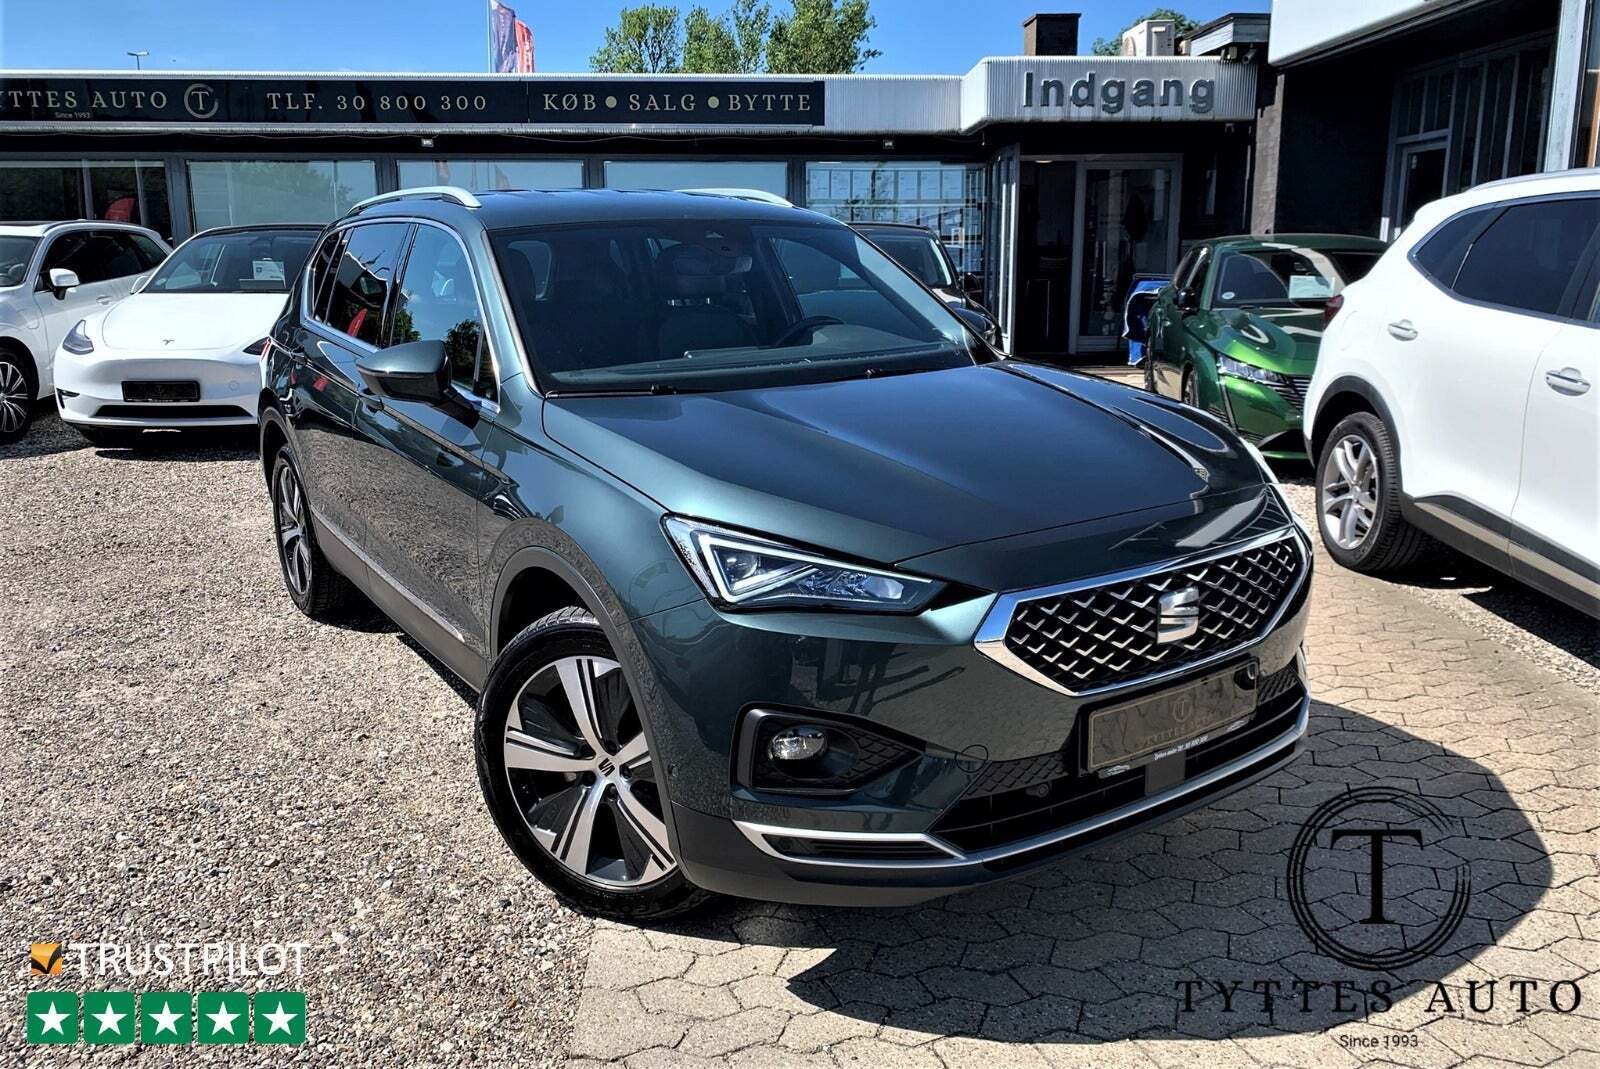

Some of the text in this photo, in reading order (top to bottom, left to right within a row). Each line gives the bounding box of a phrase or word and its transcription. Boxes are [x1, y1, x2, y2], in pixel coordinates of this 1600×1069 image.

[0, 90, 167, 109] TTES AUTO
[267, 92, 487, 111] TLF. 30 800 300
[1024, 71, 1215, 114] Indgang
[543, 93, 811, 112] KØB SALG BYTTE
[54, 111, 73, 119] Since
